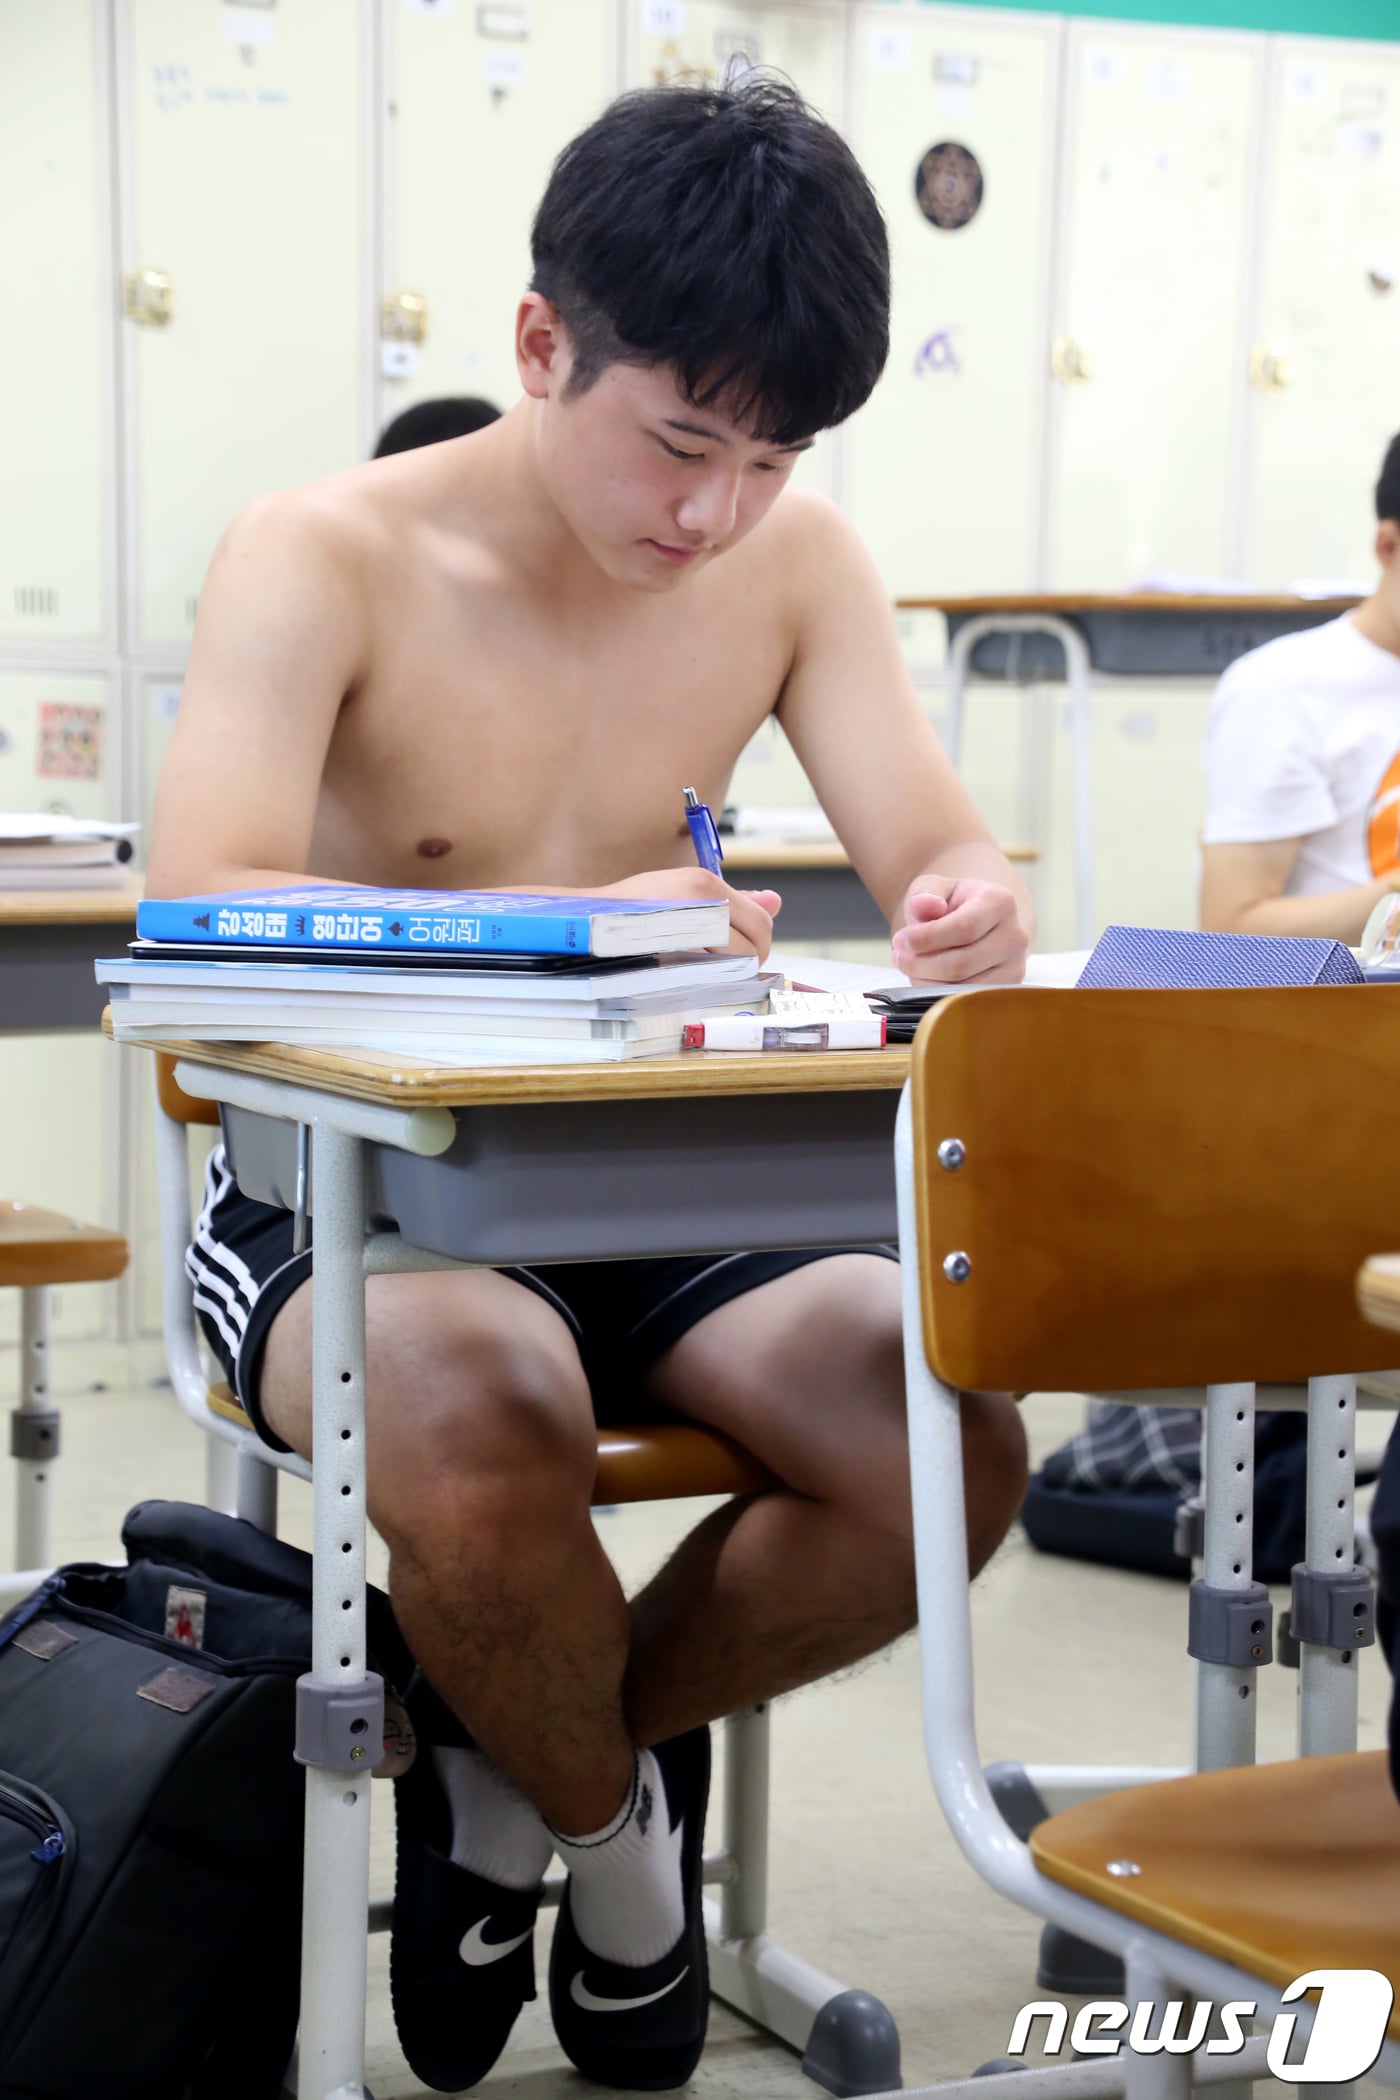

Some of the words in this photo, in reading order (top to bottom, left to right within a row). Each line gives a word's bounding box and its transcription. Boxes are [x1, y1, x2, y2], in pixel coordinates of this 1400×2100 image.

[217, 908, 288, 938] 강성태
[312, 912, 384, 942] 영단어
[408, 916, 481, 944] 어원편
